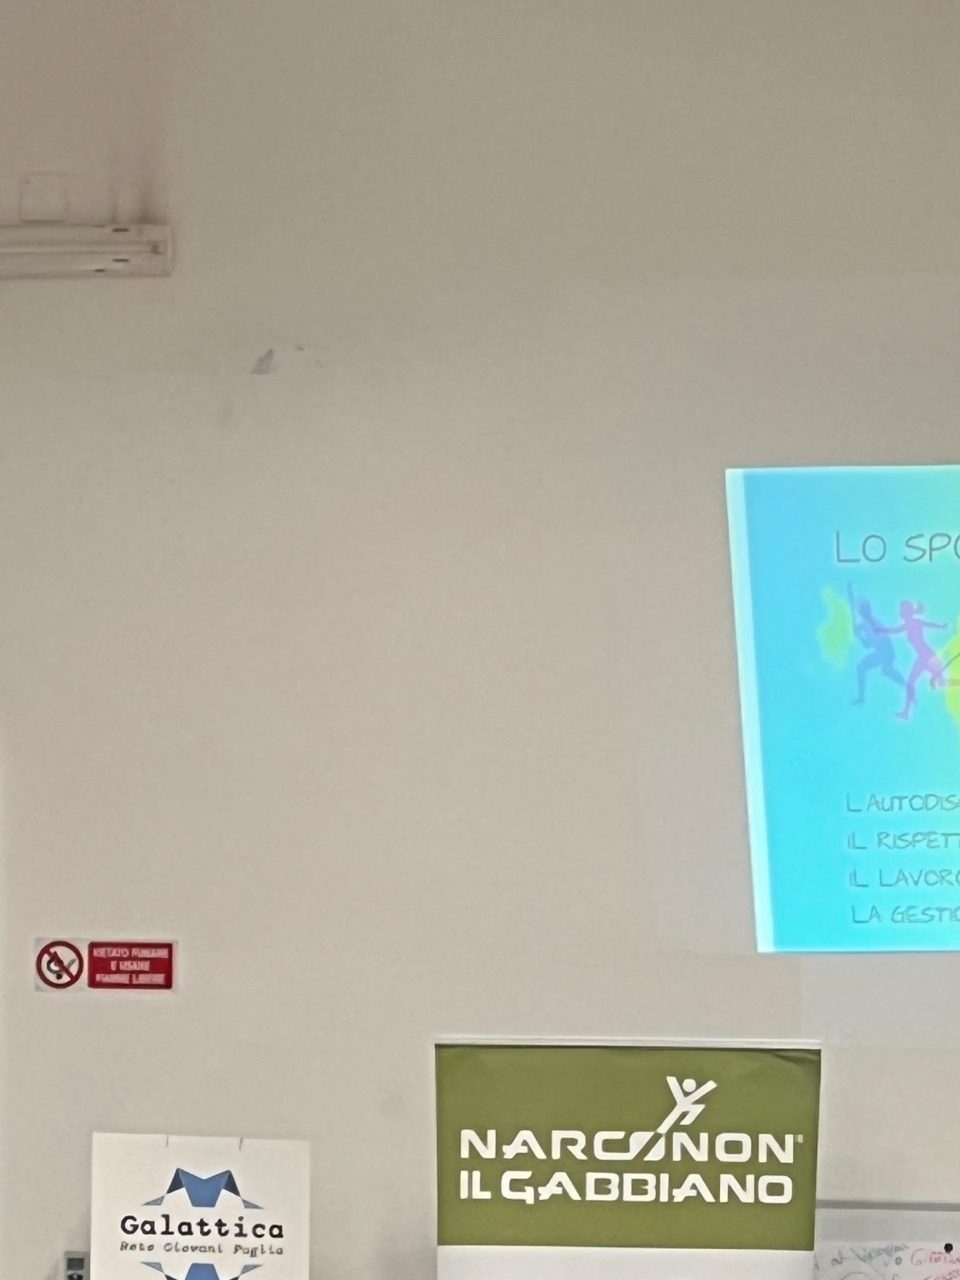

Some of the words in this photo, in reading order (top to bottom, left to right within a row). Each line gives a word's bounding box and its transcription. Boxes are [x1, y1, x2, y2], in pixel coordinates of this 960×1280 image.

[835, 530, 887, 563] LO
[847, 834, 867, 850] IL
[850, 870, 869, 887] IL
[851, 905, 881, 923] LA
[459, 1170, 492, 1199] IL
[500, 1170, 793, 1204] GABBIANO
[120, 1214, 284, 1239] Galattica
